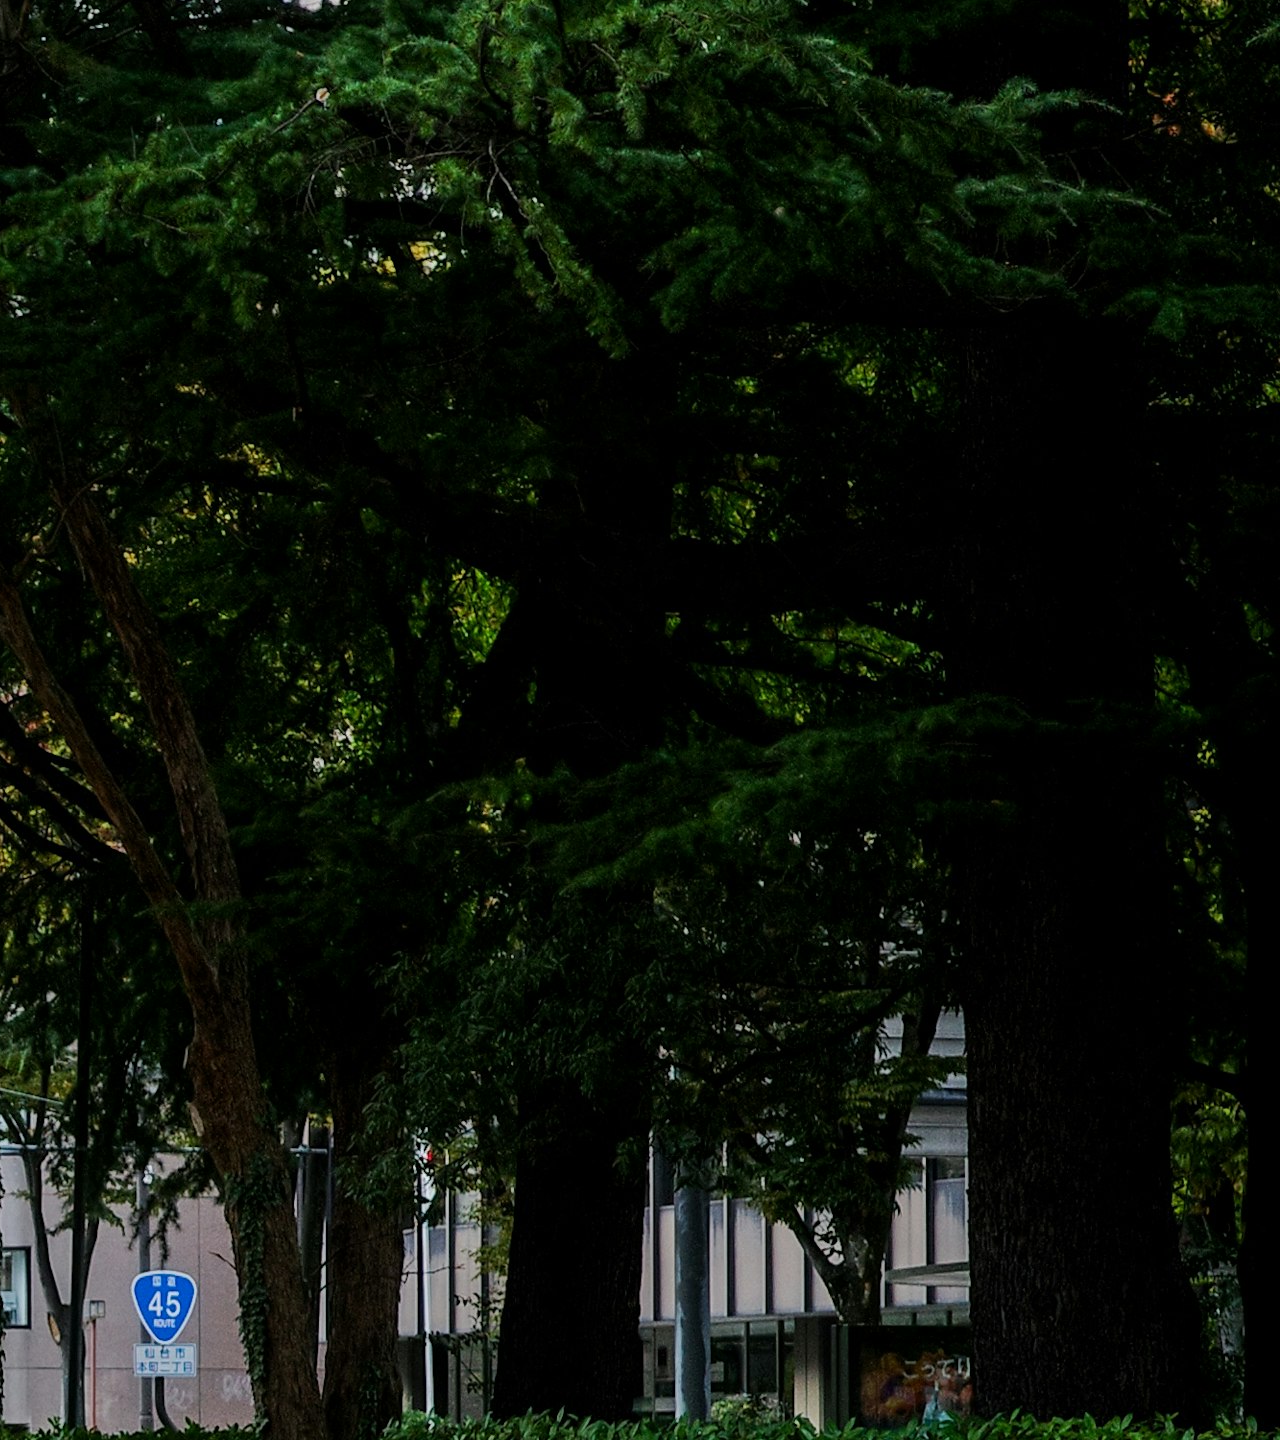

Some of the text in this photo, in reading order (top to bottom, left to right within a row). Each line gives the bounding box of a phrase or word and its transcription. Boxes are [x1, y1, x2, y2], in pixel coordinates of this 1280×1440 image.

[148, 1291, 181, 1317] 45
[153, 1318, 176, 1328] ROUTE
[145, 1348, 186, 1359] 仙台市
[137, 1362, 193, 1373] 本町二丁目
